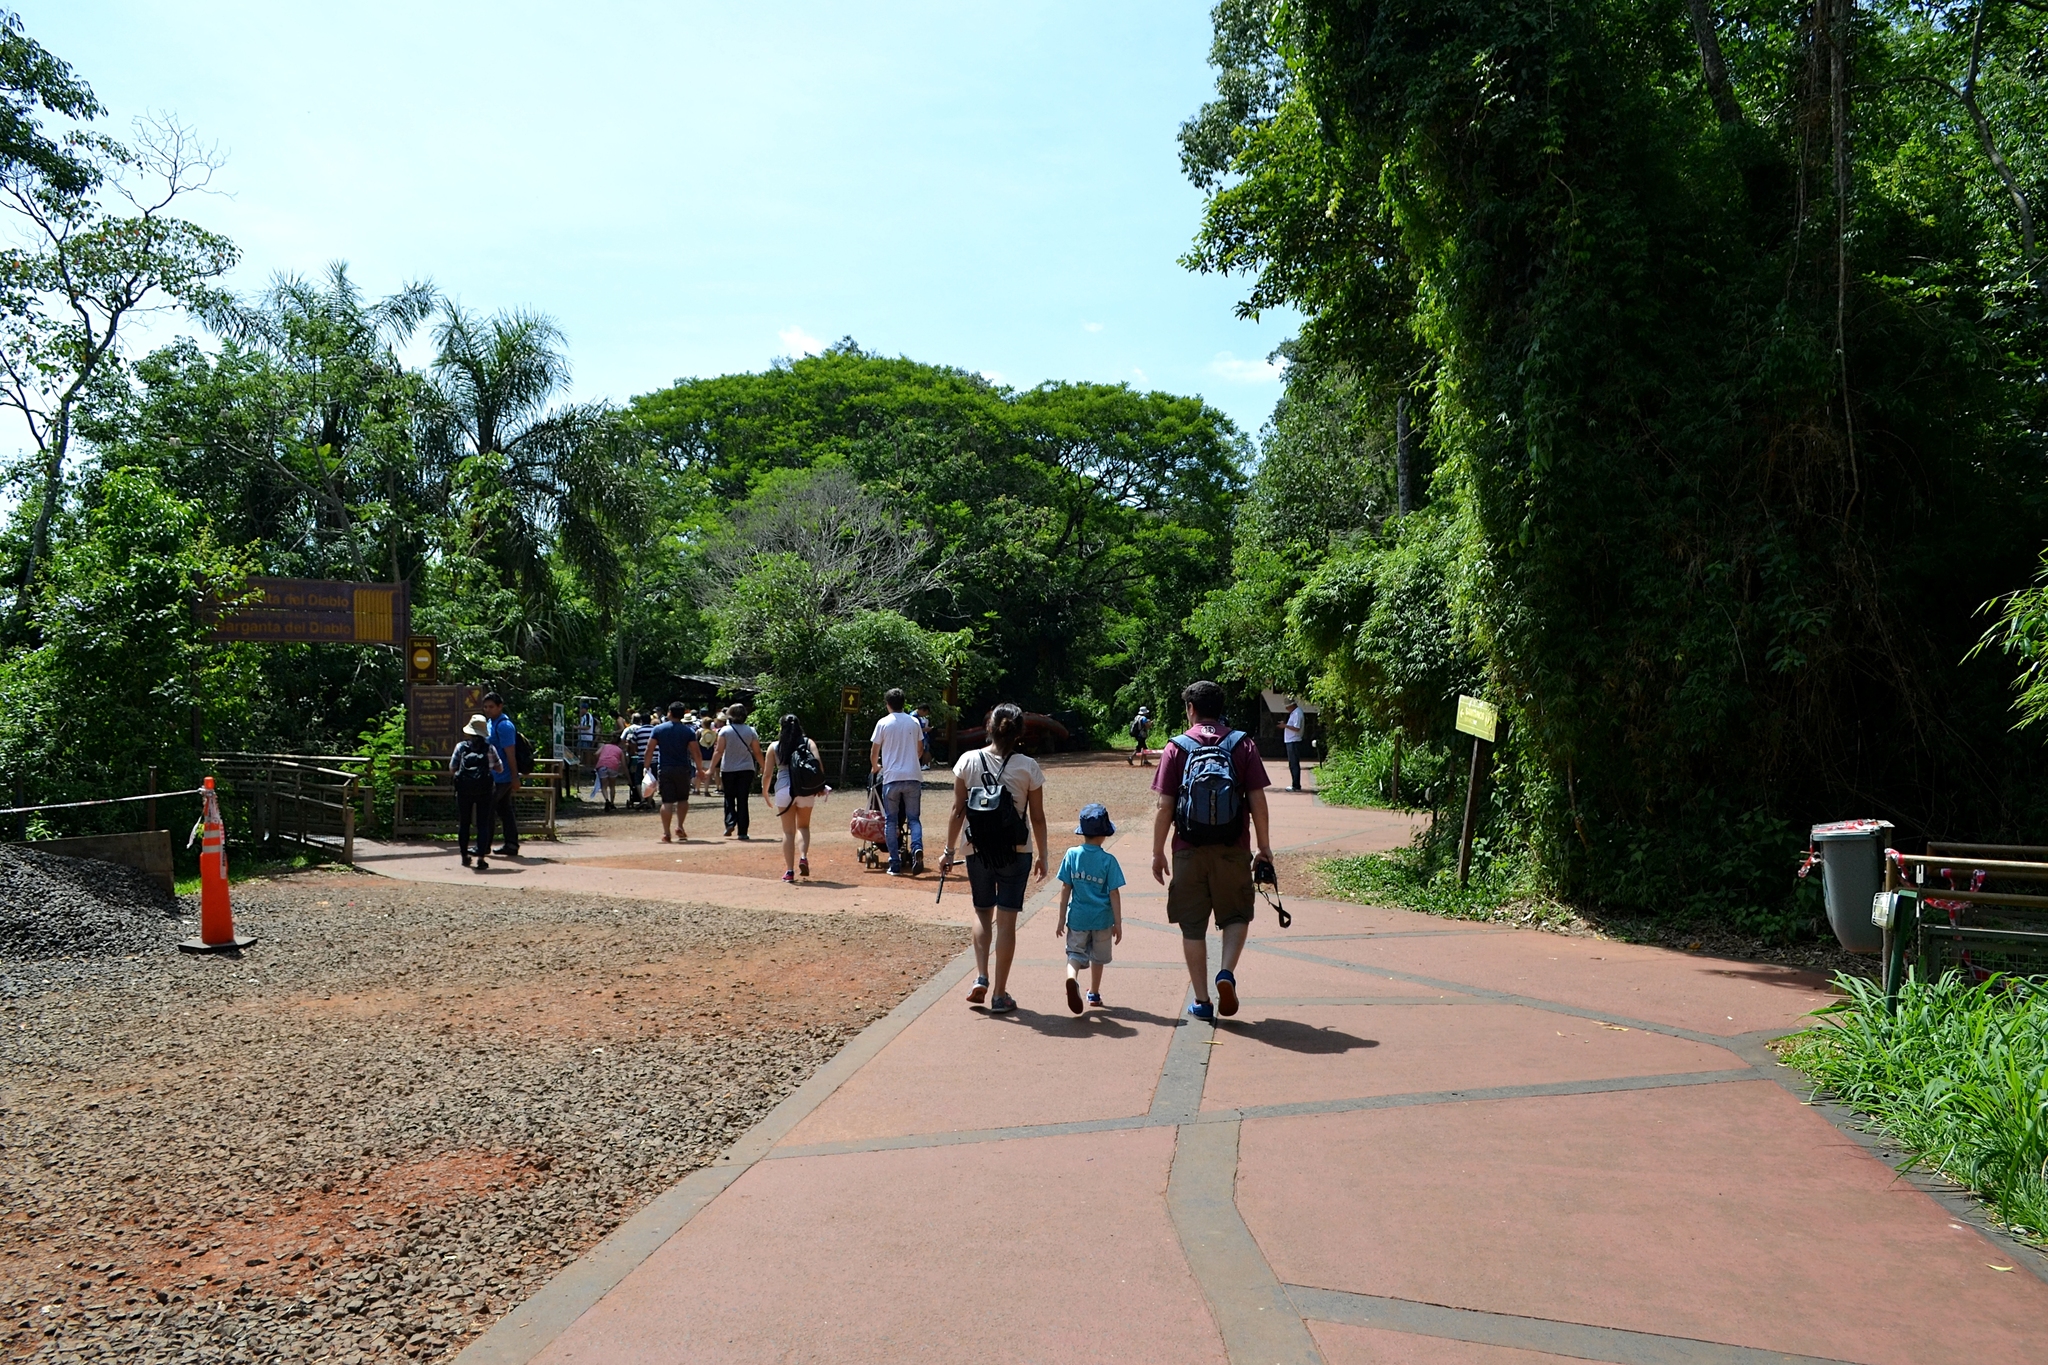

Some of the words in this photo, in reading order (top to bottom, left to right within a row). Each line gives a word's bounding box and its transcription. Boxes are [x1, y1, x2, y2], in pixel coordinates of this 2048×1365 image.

[284, 593, 304, 606] del
[308, 593, 349, 607] Diablo
[214, 620, 281, 635] Garganta
[284, 621, 305, 634] del
[309, 620, 351, 635] Diablo
